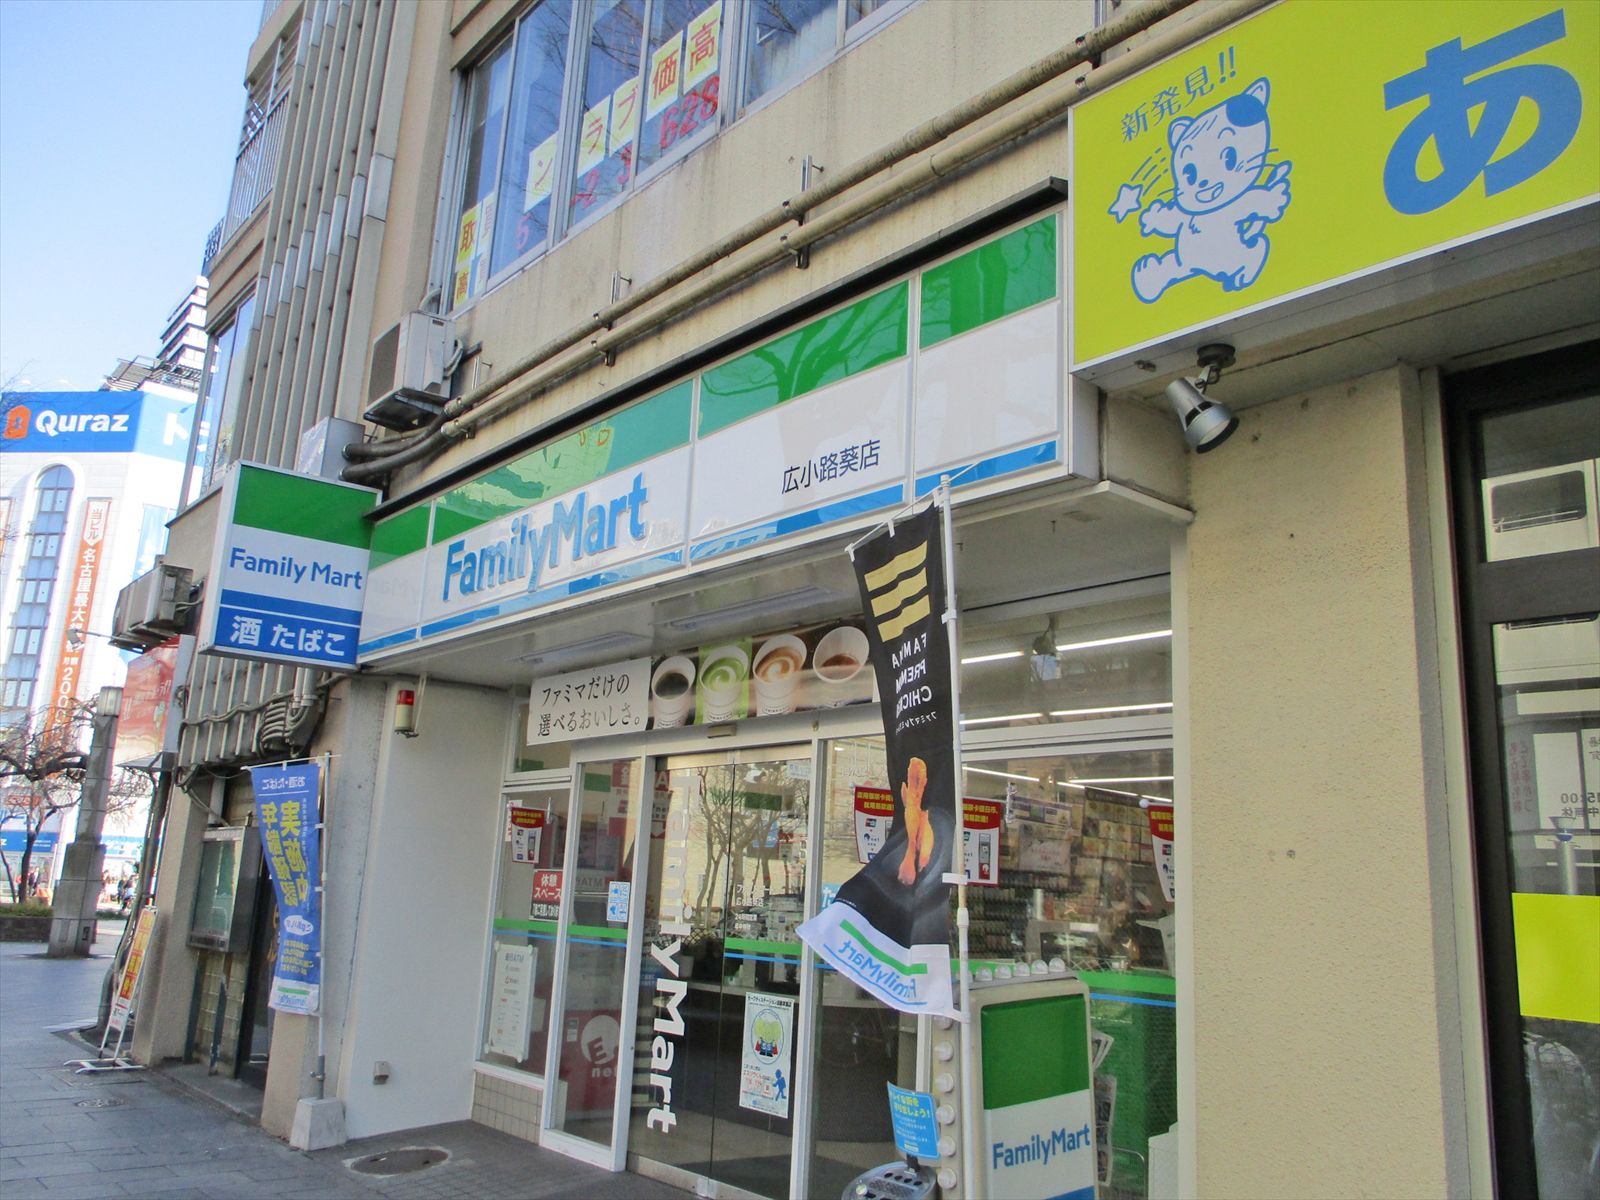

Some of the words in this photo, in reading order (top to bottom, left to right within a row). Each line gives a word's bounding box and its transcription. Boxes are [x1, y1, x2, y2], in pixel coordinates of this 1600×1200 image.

[660, 76, 720, 149] 628
[1383, 8, 1582, 215] あ
[35, 409, 130, 437] Quraz
[781, 439, 881, 495] 広小路葵店
[442, 471, 648, 602] FamilyMart
[229, 614, 263, 647] 酒
[270, 622, 346, 657] たばこ
[541, 673, 630, 708] ファミマだけの
[537, 701, 641, 738] 選べるおいしさ。
[992, 1123, 1091, 1170] FamilyMart
